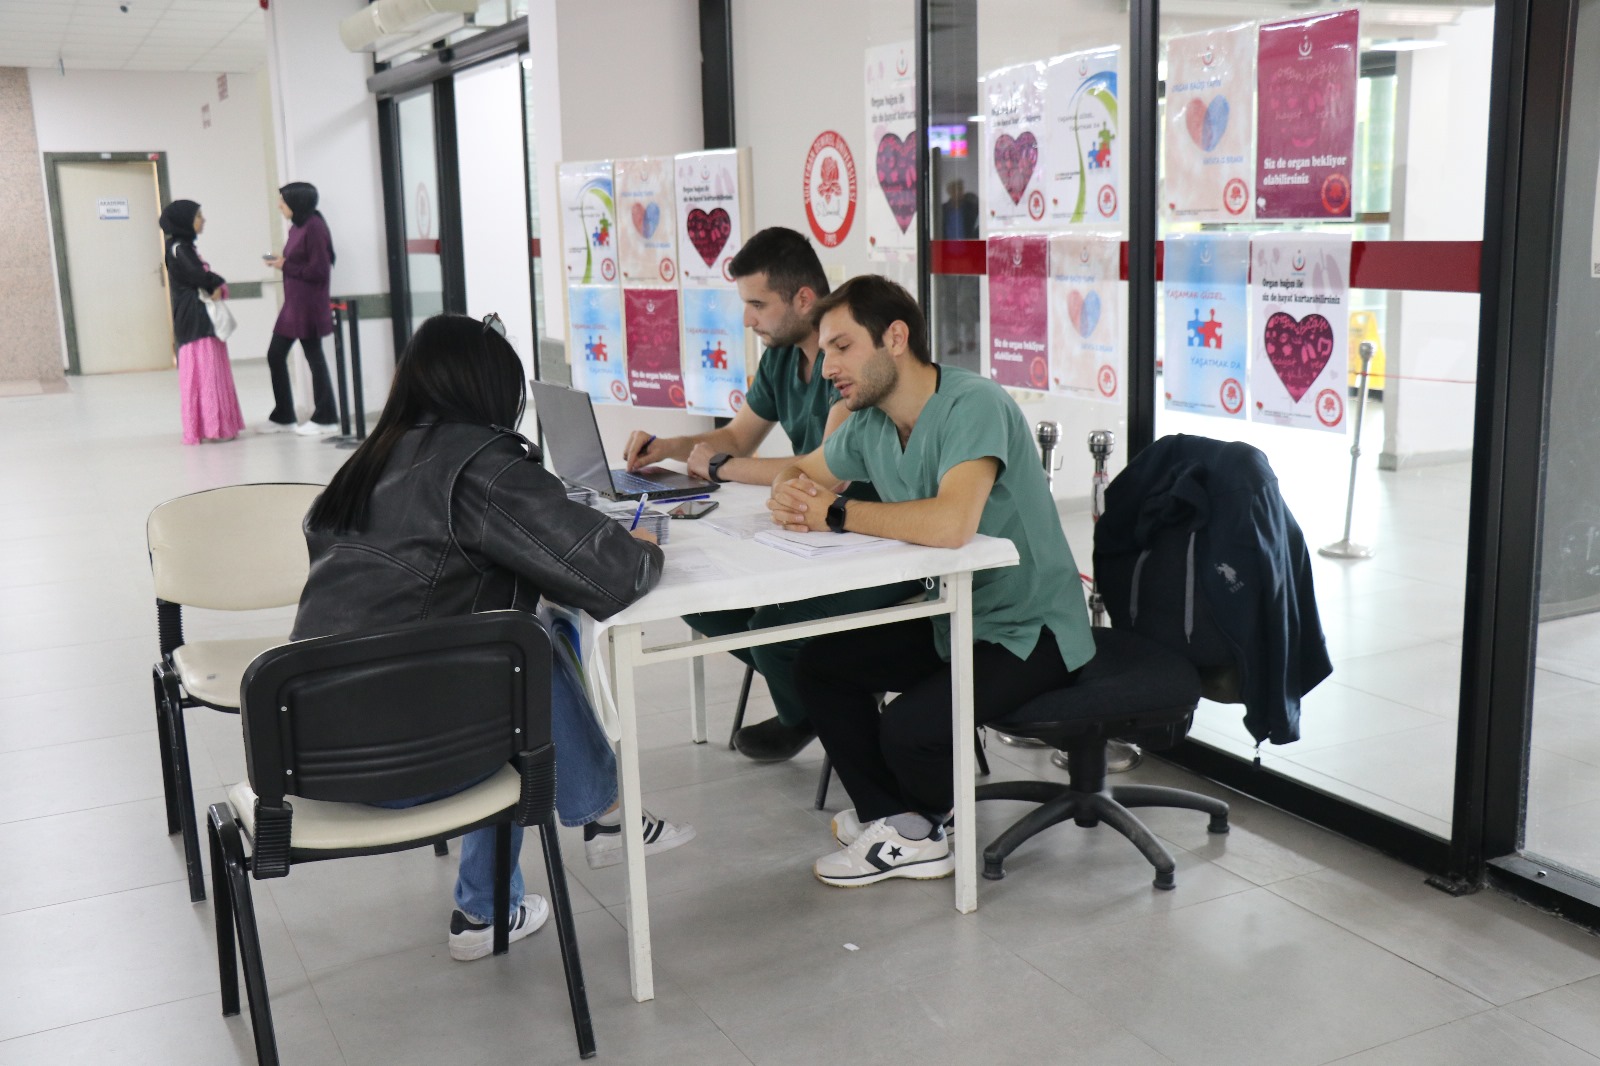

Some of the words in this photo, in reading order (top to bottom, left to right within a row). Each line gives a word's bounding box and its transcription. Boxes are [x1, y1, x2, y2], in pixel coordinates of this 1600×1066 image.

[1264, 157, 1276, 170] Siz
[1277, 157, 1286, 168] de
[1287, 158, 1310, 170] organ
[1311, 154, 1347, 168] bekliyor
[1263, 173, 1309, 186] olabilirsiniz
[1262, 278, 1278, 289] Organ
[1166, 288, 1199, 300] YAŞAMAK
[1271, 292, 1277, 302] de
[1278, 293, 1293, 304] hayat
[1294, 293, 1341, 304] kurtarabilirsiniz
